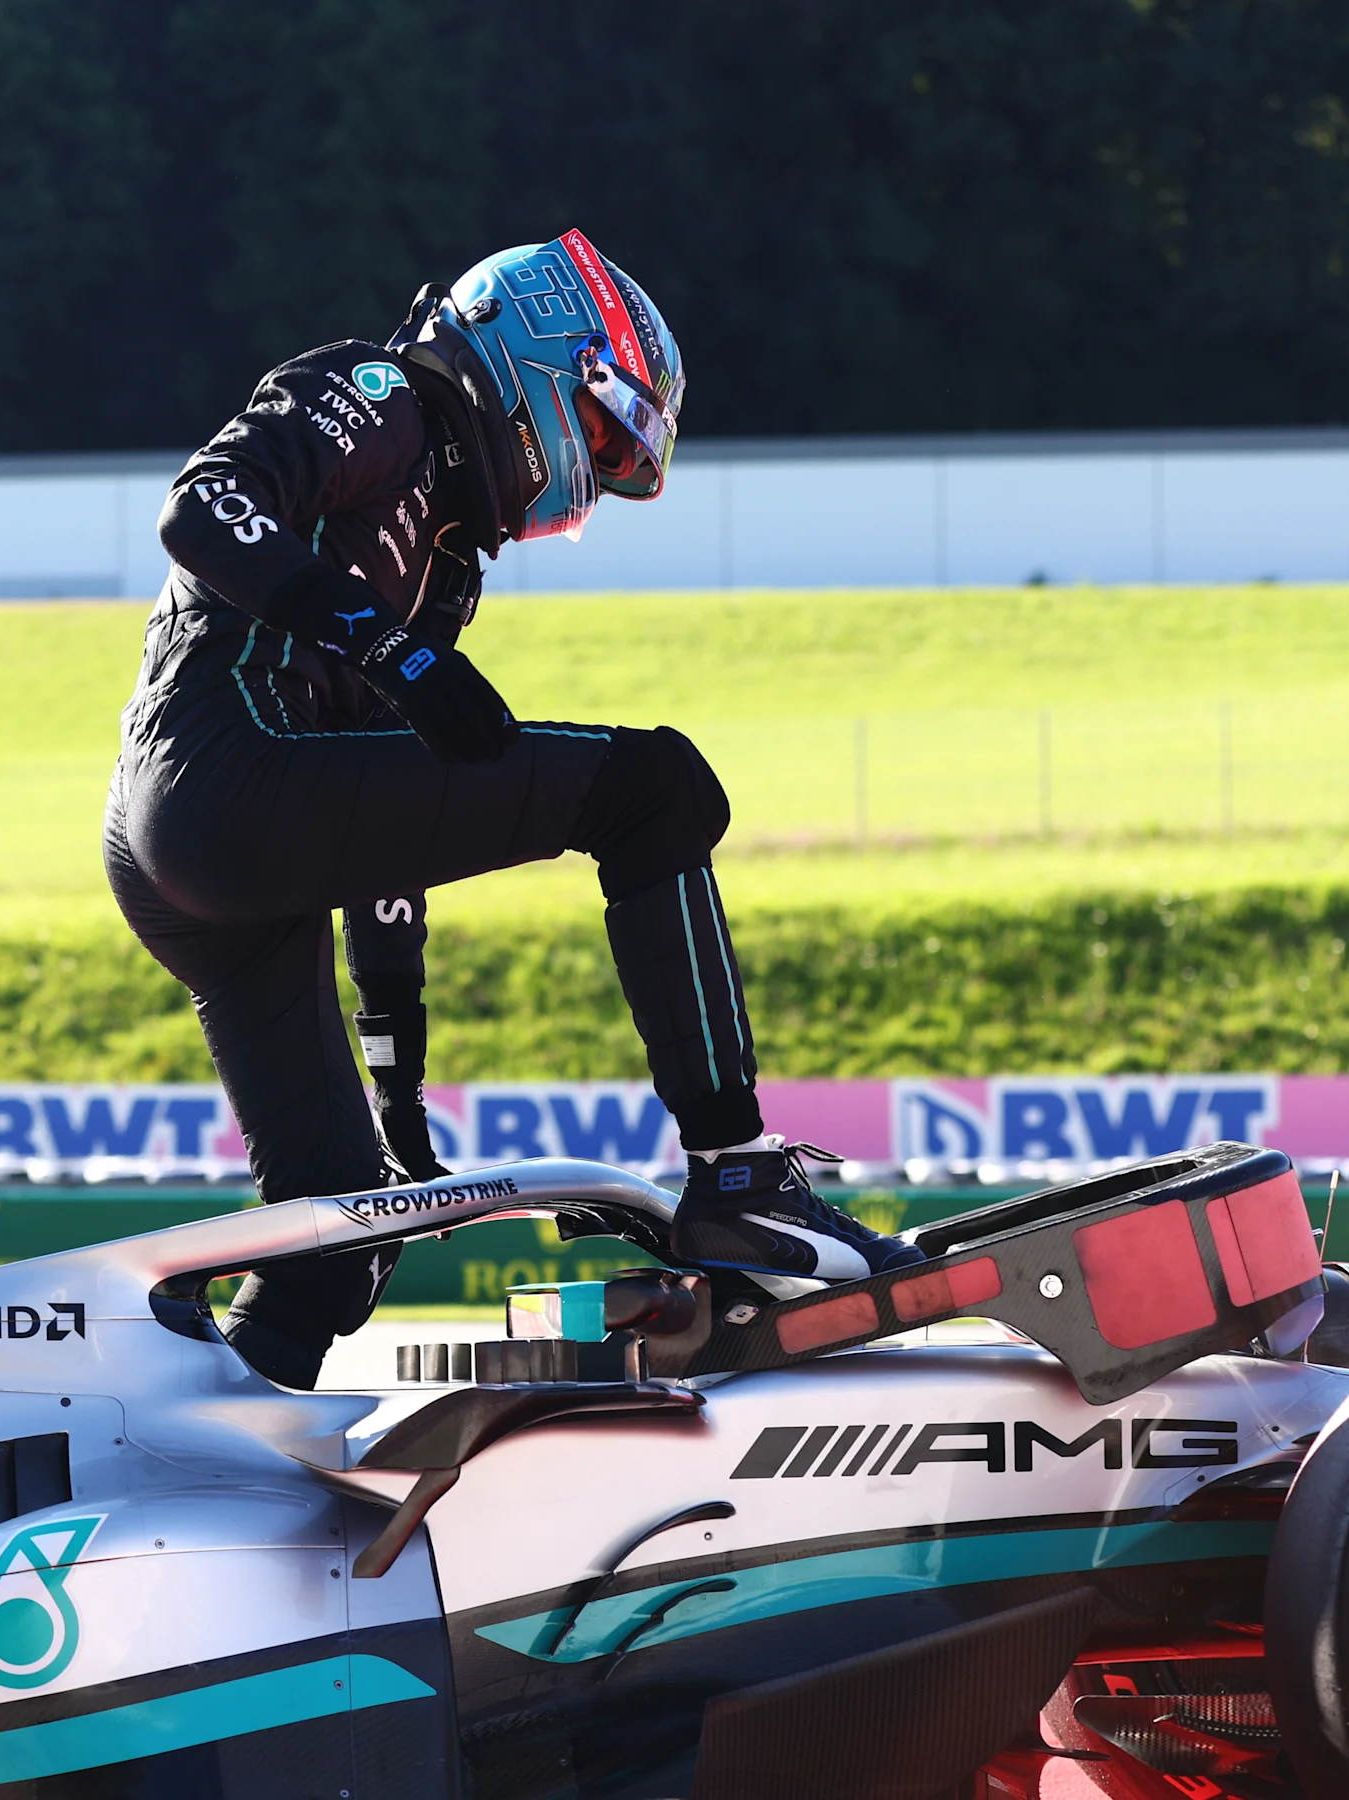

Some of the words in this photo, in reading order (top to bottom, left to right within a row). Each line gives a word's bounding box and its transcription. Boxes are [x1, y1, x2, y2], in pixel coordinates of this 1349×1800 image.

[572, 237, 616, 310] CROWDSTRIKE
[304, 405, 342, 438] MD
[319, 389, 366, 430] IWC
[325, 370, 384, 427] PETRONAS
[374, 630, 410, 663] IWC
[477, 1096, 672, 1160] BW
[1001, 1088, 1266, 1158] BWT
[352, 1176, 519, 1219] CROWDSTRIKE
[892, 1418, 1238, 1475] AMG
